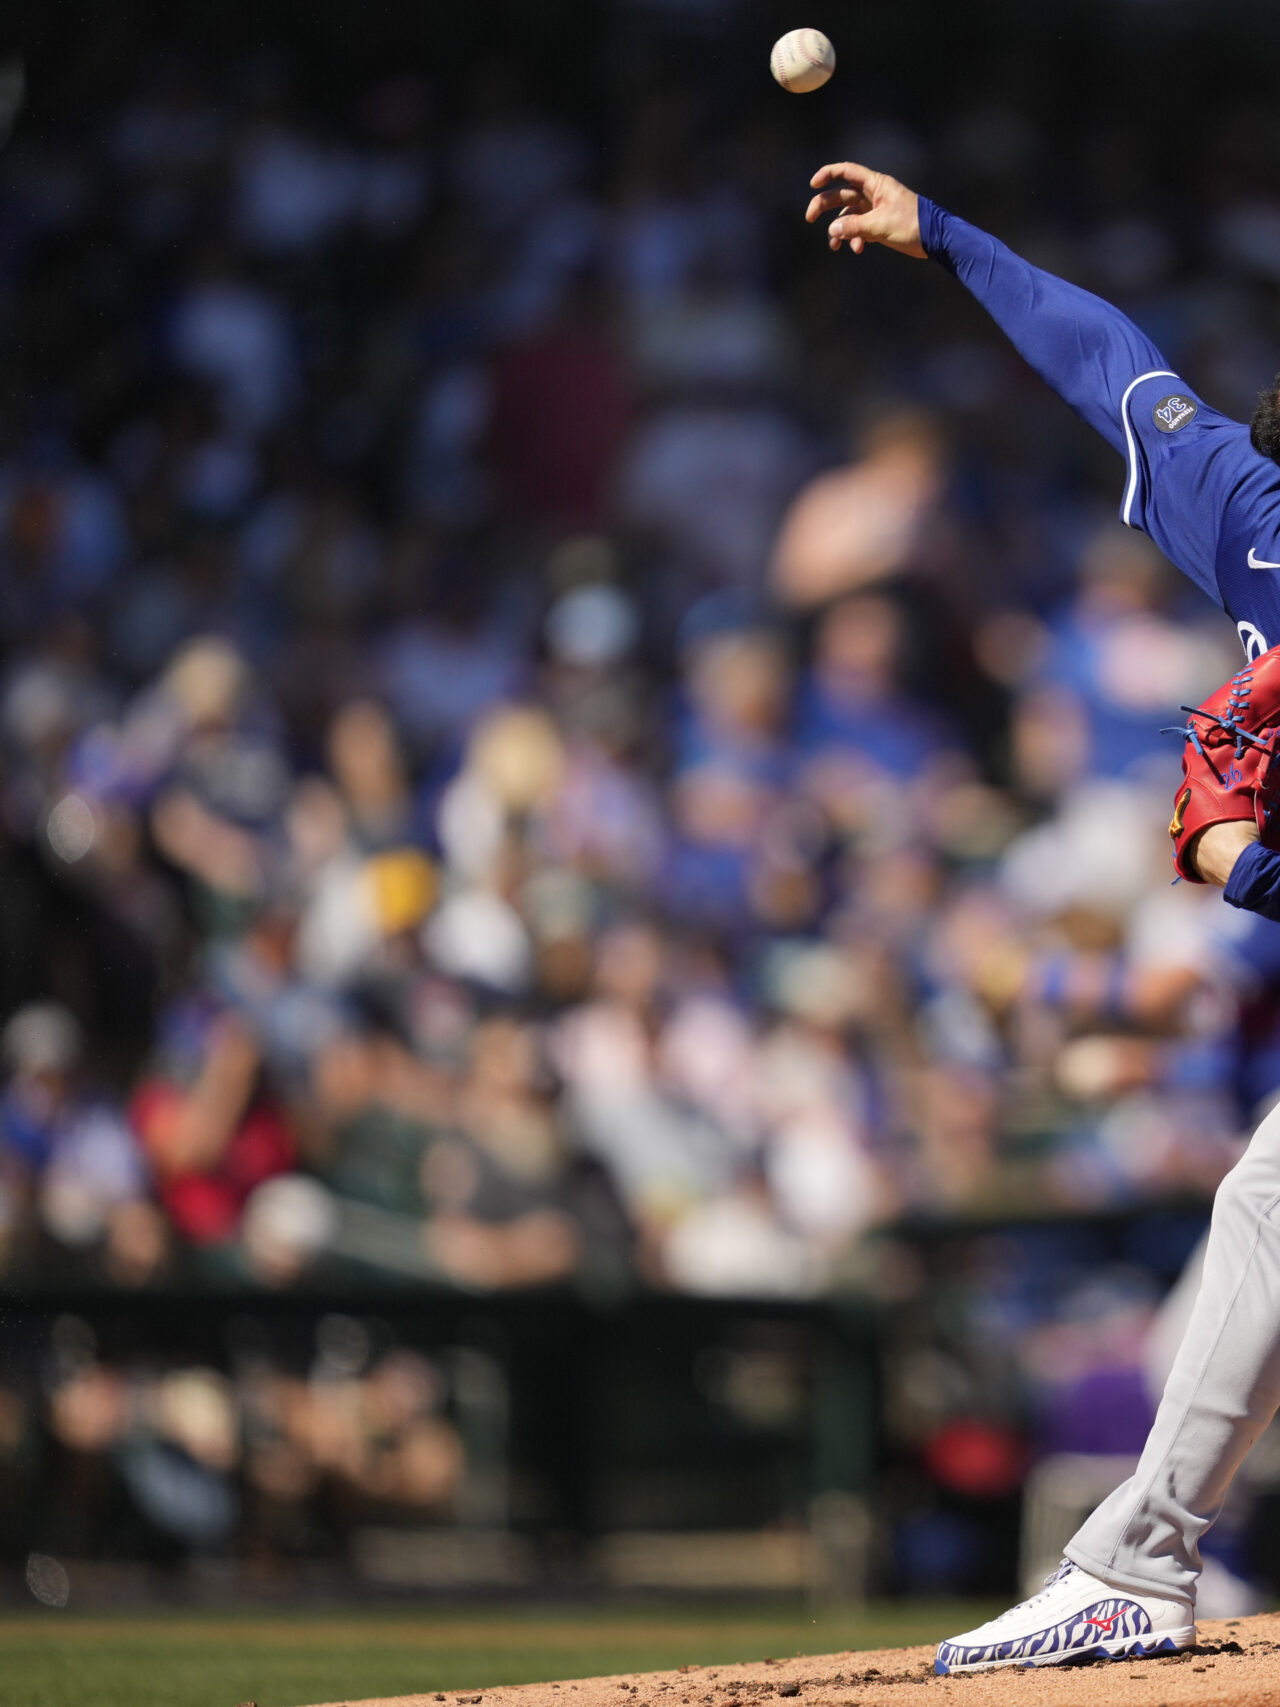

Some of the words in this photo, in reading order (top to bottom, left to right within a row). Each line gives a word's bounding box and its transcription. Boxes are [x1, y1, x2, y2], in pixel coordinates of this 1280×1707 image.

[1156, 397, 1186, 424] 34
[1168, 406, 1194, 429] FERNANDO
[1221, 762, 1242, 790] 26
